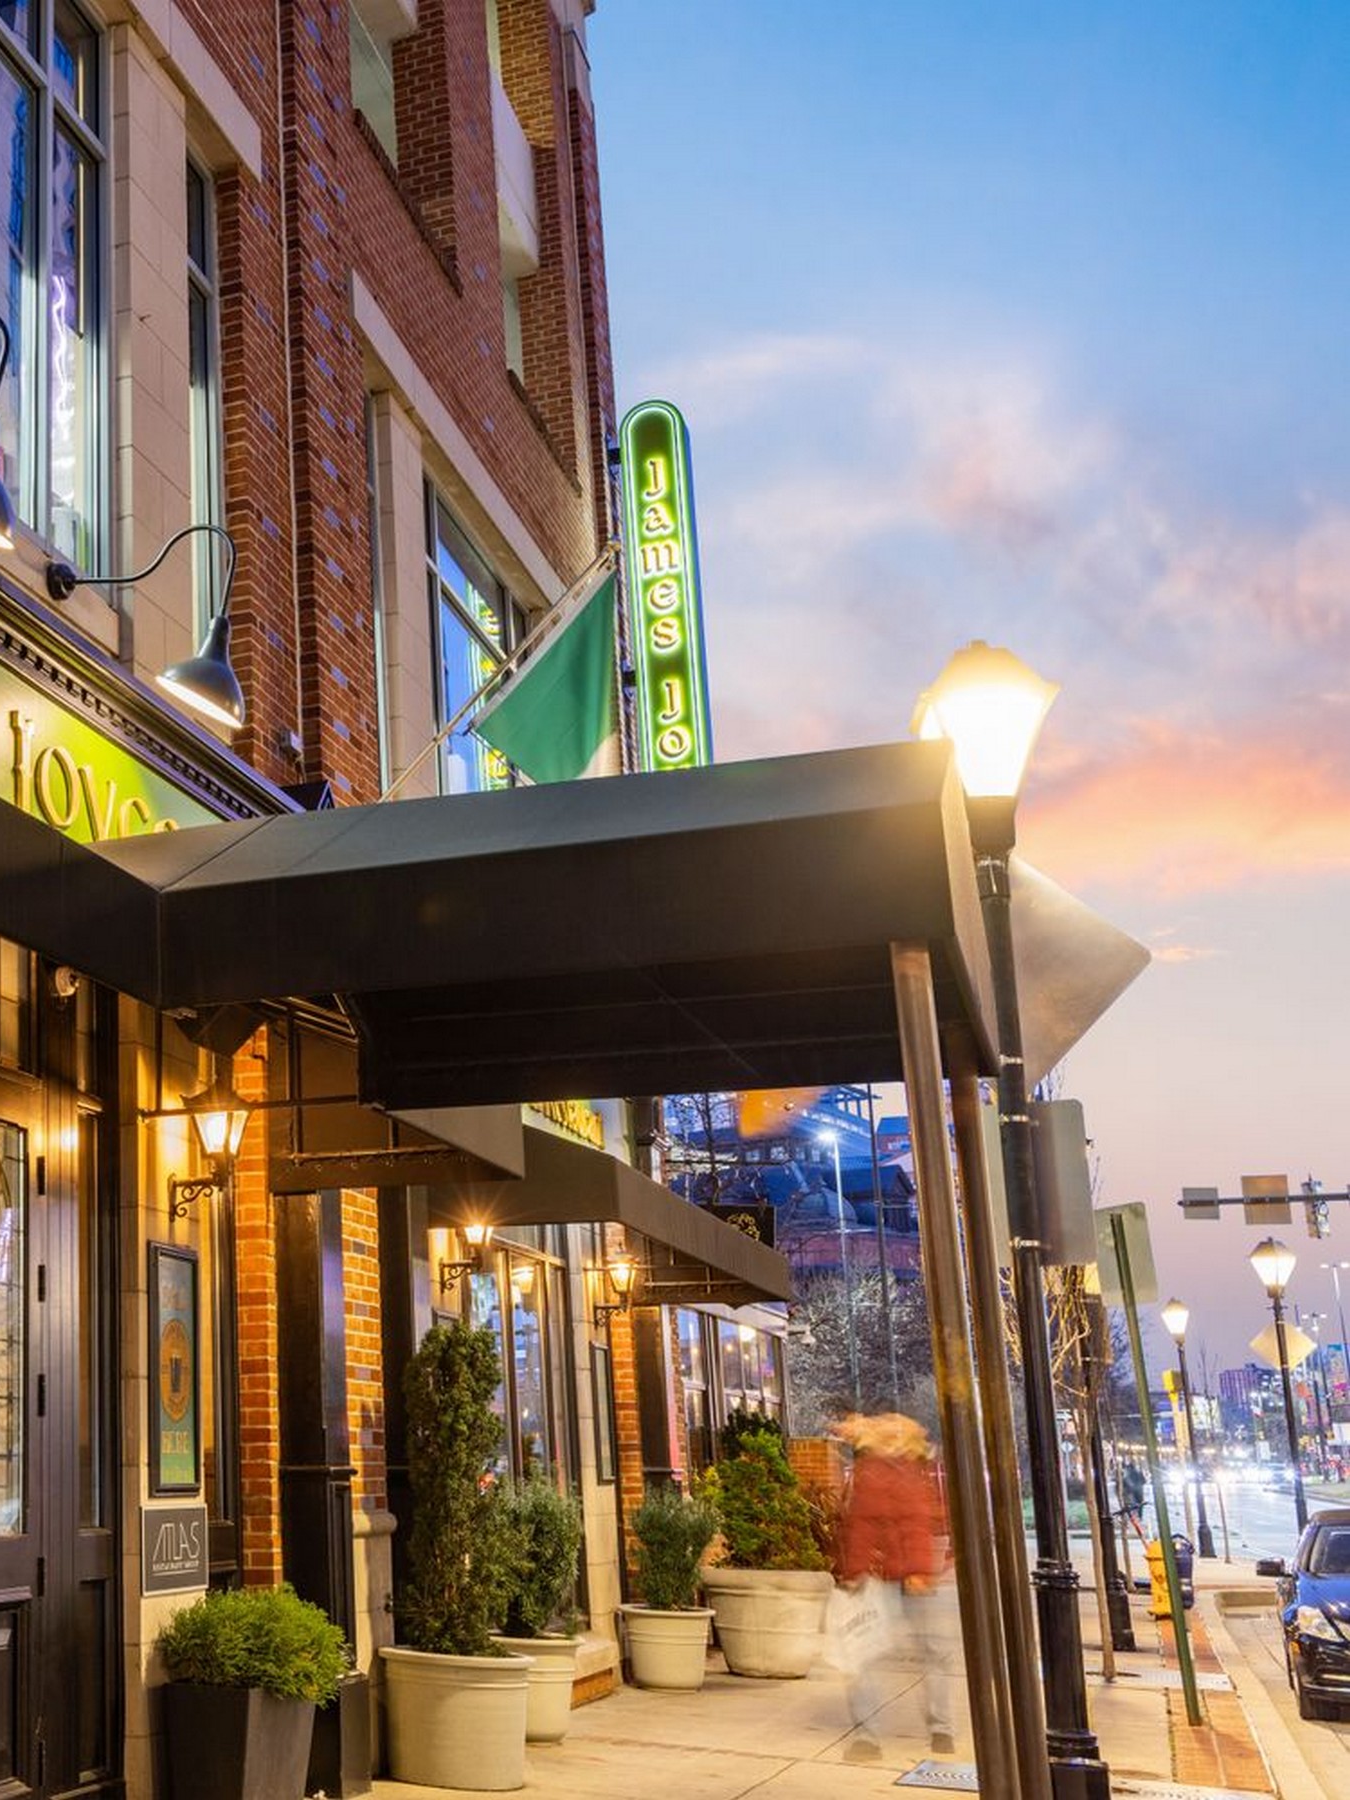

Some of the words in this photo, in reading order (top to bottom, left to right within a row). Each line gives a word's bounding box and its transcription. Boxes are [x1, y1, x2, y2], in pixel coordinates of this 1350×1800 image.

[640, 459, 679, 650] James
[9, 709, 179, 843] Joyc
[152, 1521, 201, 1561] ATLAS
